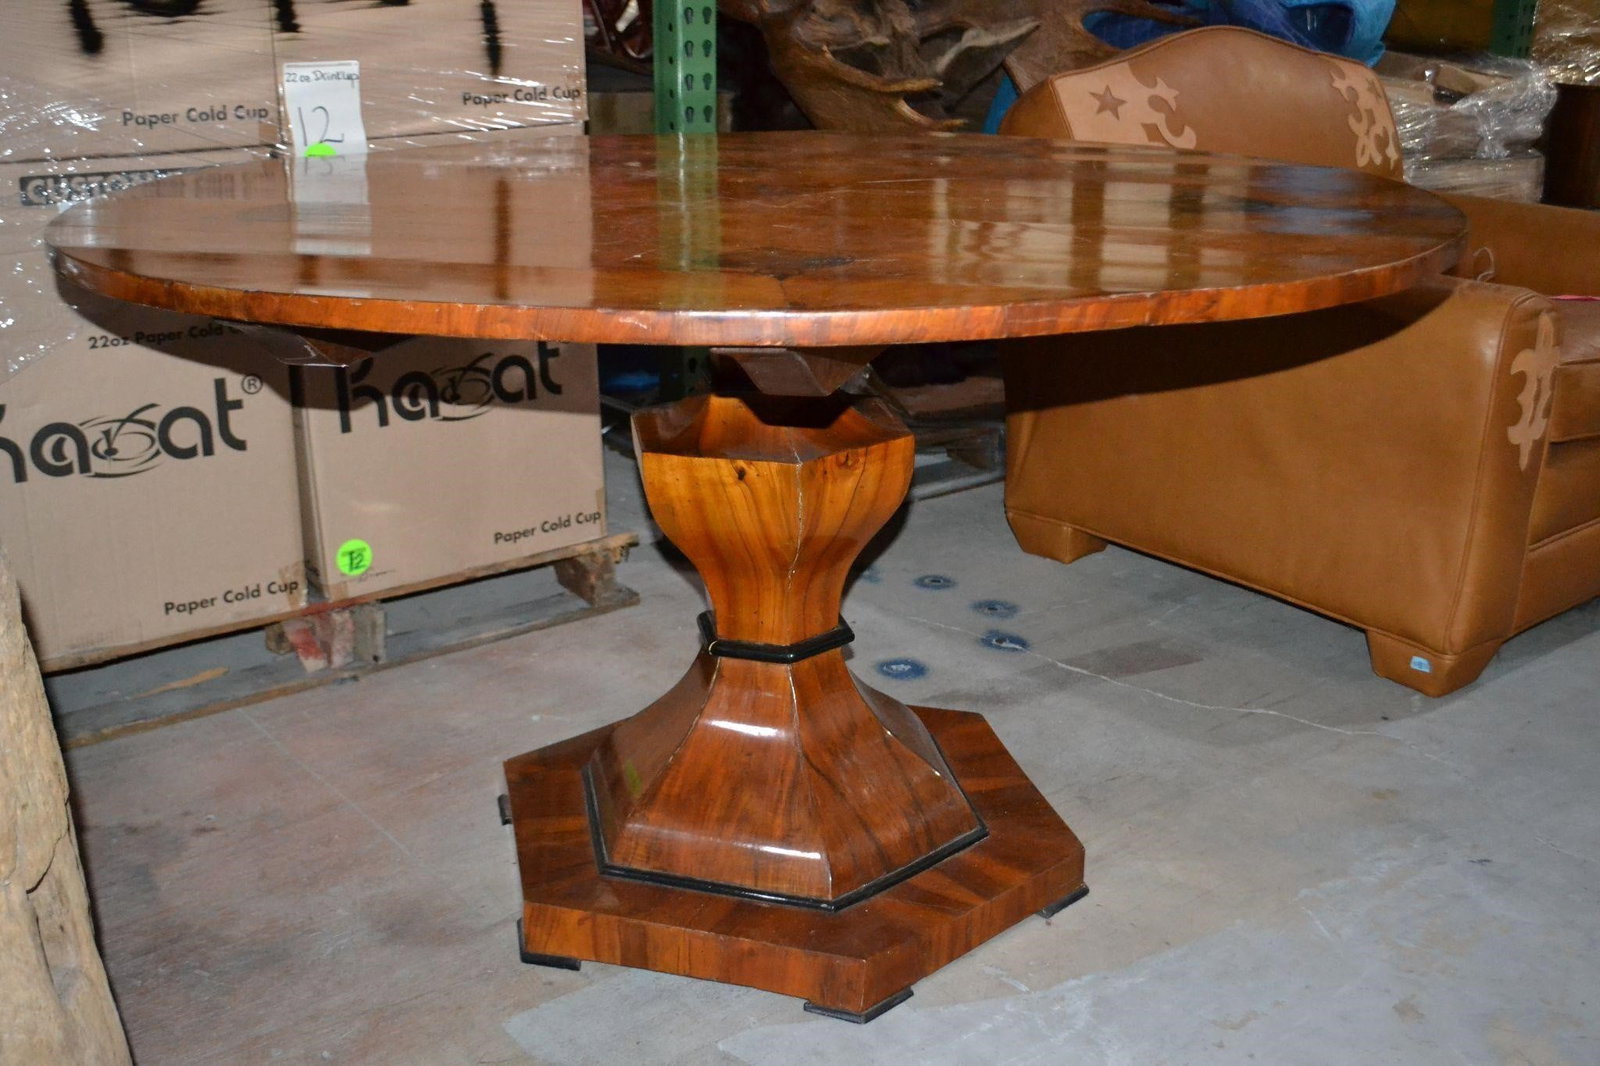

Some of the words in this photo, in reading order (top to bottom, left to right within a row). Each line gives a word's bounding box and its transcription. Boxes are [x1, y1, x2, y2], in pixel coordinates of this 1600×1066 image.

[286, 72, 298, 82] 22
[462, 92, 509, 108] Paper
[514, 85, 548, 101] Cold
[553, 86, 580, 100] Cup
[122, 111, 179, 129] Paper
[186, 105, 228, 122] Cold
[234, 105, 269, 122] Cup
[298, 105, 345, 147] 12
[88, 335, 130, 350] 22oz
[134, 331, 183, 345] Paper
[187, 323, 223, 339] Cold
[494, 527, 537, 544] Paper
[541, 515, 571, 533] Cold
[576, 511, 601, 524] Cup
[164, 597, 217, 615] Paper
[223, 583, 260, 603] Cold
[267, 580, 299, 594] Cup
